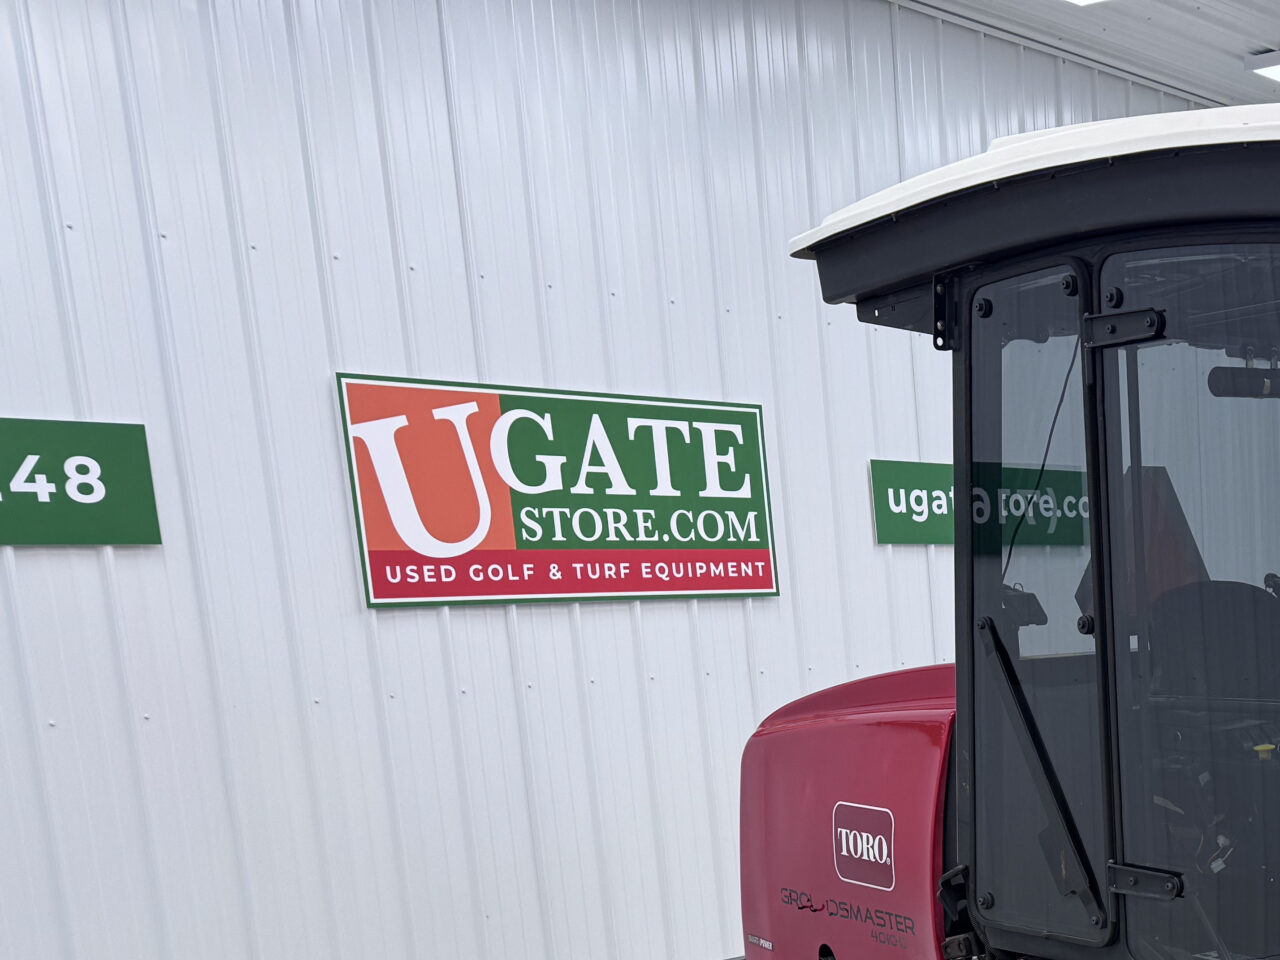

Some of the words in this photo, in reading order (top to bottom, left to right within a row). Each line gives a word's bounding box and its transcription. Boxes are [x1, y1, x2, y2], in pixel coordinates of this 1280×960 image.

[0, 454, 106, 504] 48
[350, 401, 752, 559] UGATE
[888, 485, 1090, 523] ugatore.co
[520, 506, 760, 542] STORE.COM
[385, 565, 457, 583] USED
[469, 563, 534, 582] GOLF
[549, 563, 563, 580] &
[572, 562, 630, 579] TURF
[641, 561, 765, 581] EQUIPMENT
[837, 827, 889, 864] TORO
